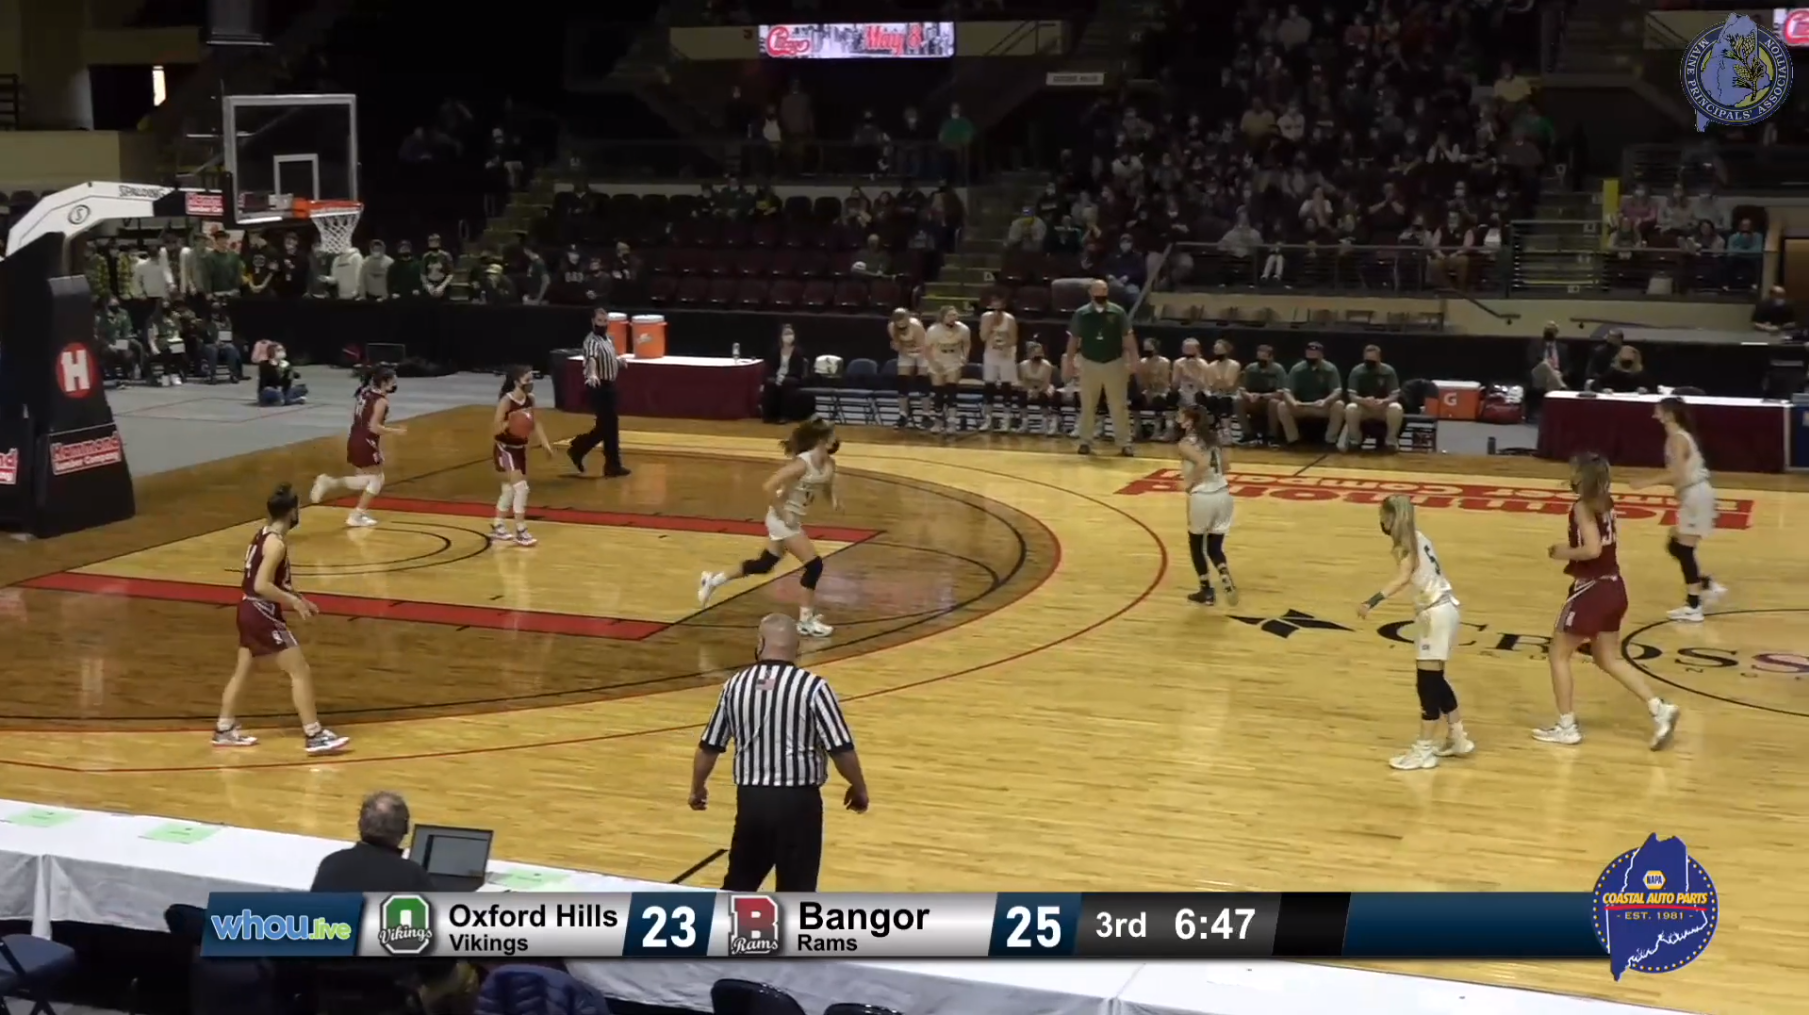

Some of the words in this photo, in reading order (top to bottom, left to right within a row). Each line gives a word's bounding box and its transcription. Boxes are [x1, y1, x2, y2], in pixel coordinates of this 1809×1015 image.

[866, 26, 905, 56] May
[908, 23, 923, 50] 8
[61, 349, 90, 392] H
[1443, 392, 1457, 406] G
[1423, 544, 1441, 575] 5
